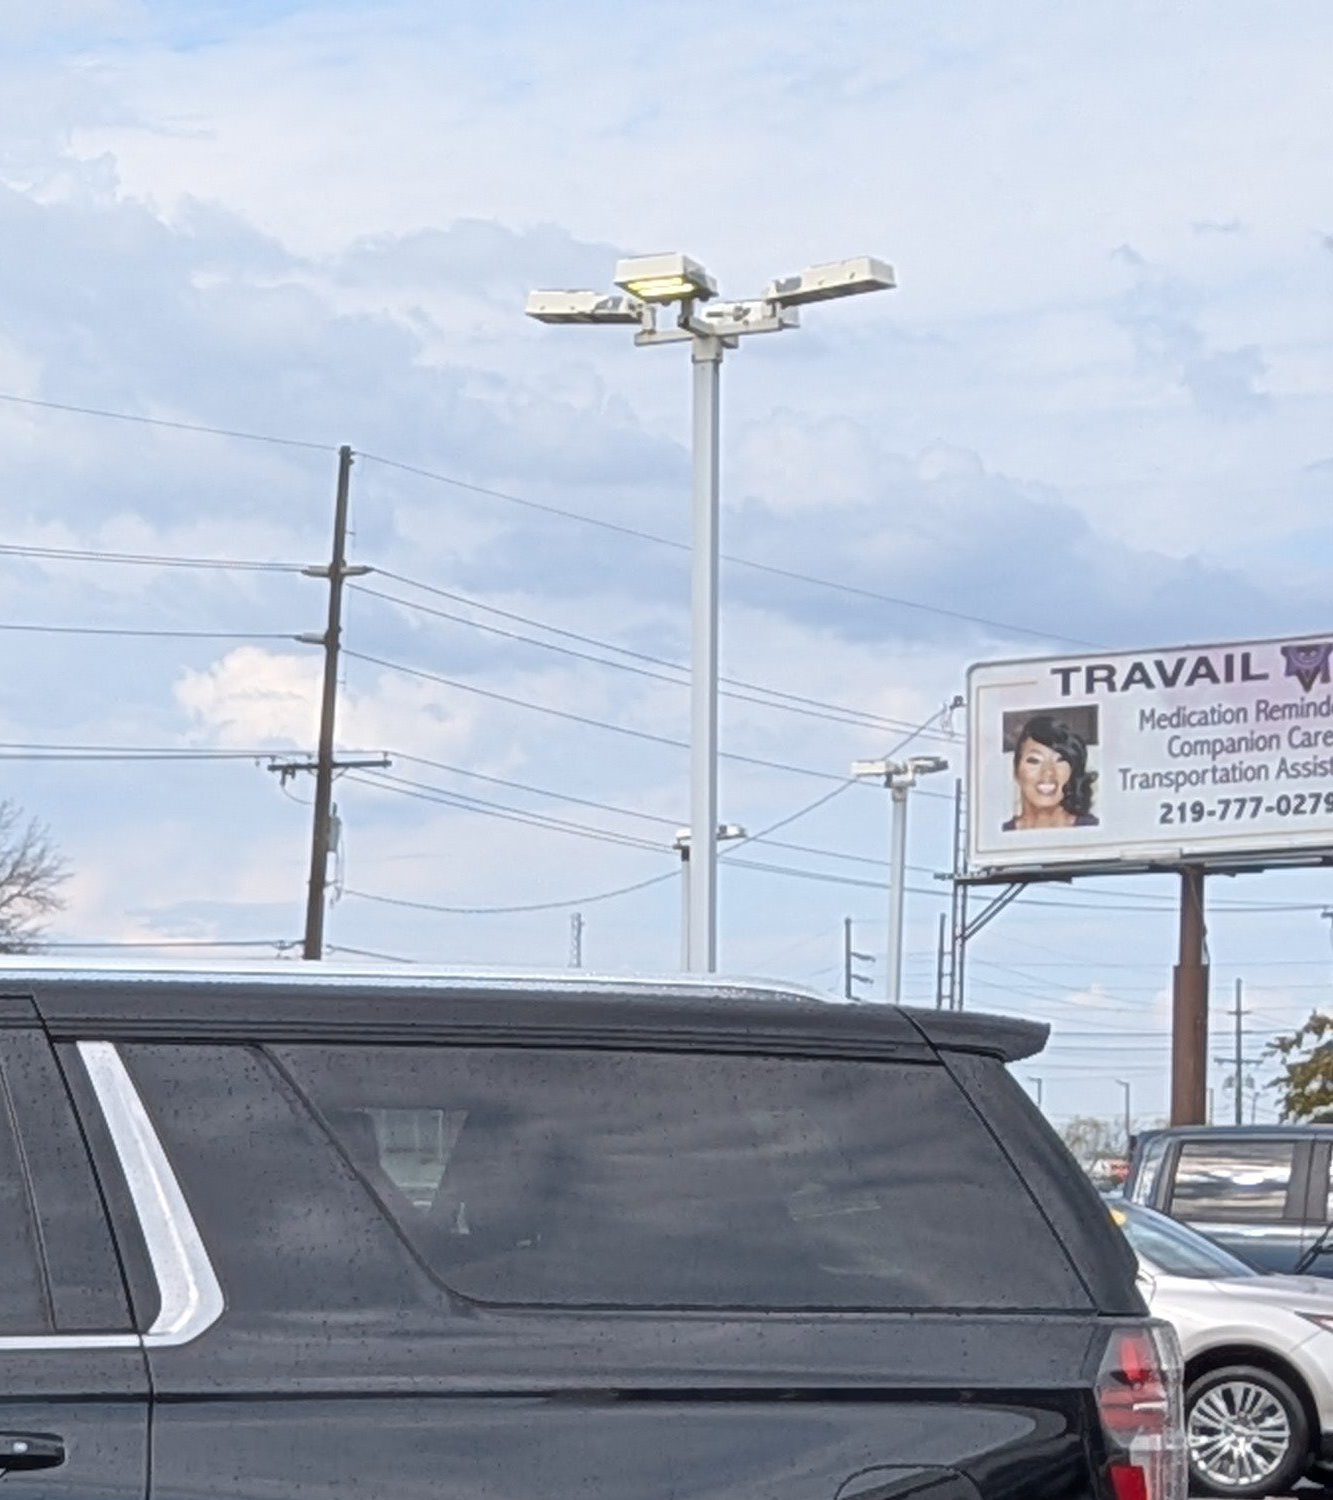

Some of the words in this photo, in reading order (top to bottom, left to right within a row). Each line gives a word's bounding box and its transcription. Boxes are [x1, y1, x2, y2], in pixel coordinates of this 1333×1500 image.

[1050, 651, 1270, 696] TRAVAIL
[1139, 703, 1248, 732] Medication
[1255, 694, 1333, 723] Remind
[1167, 730, 1281, 761] Companion
[1118, 761, 1269, 793] Transportation
[1159, 791, 1333, 824] 219-777-0279
